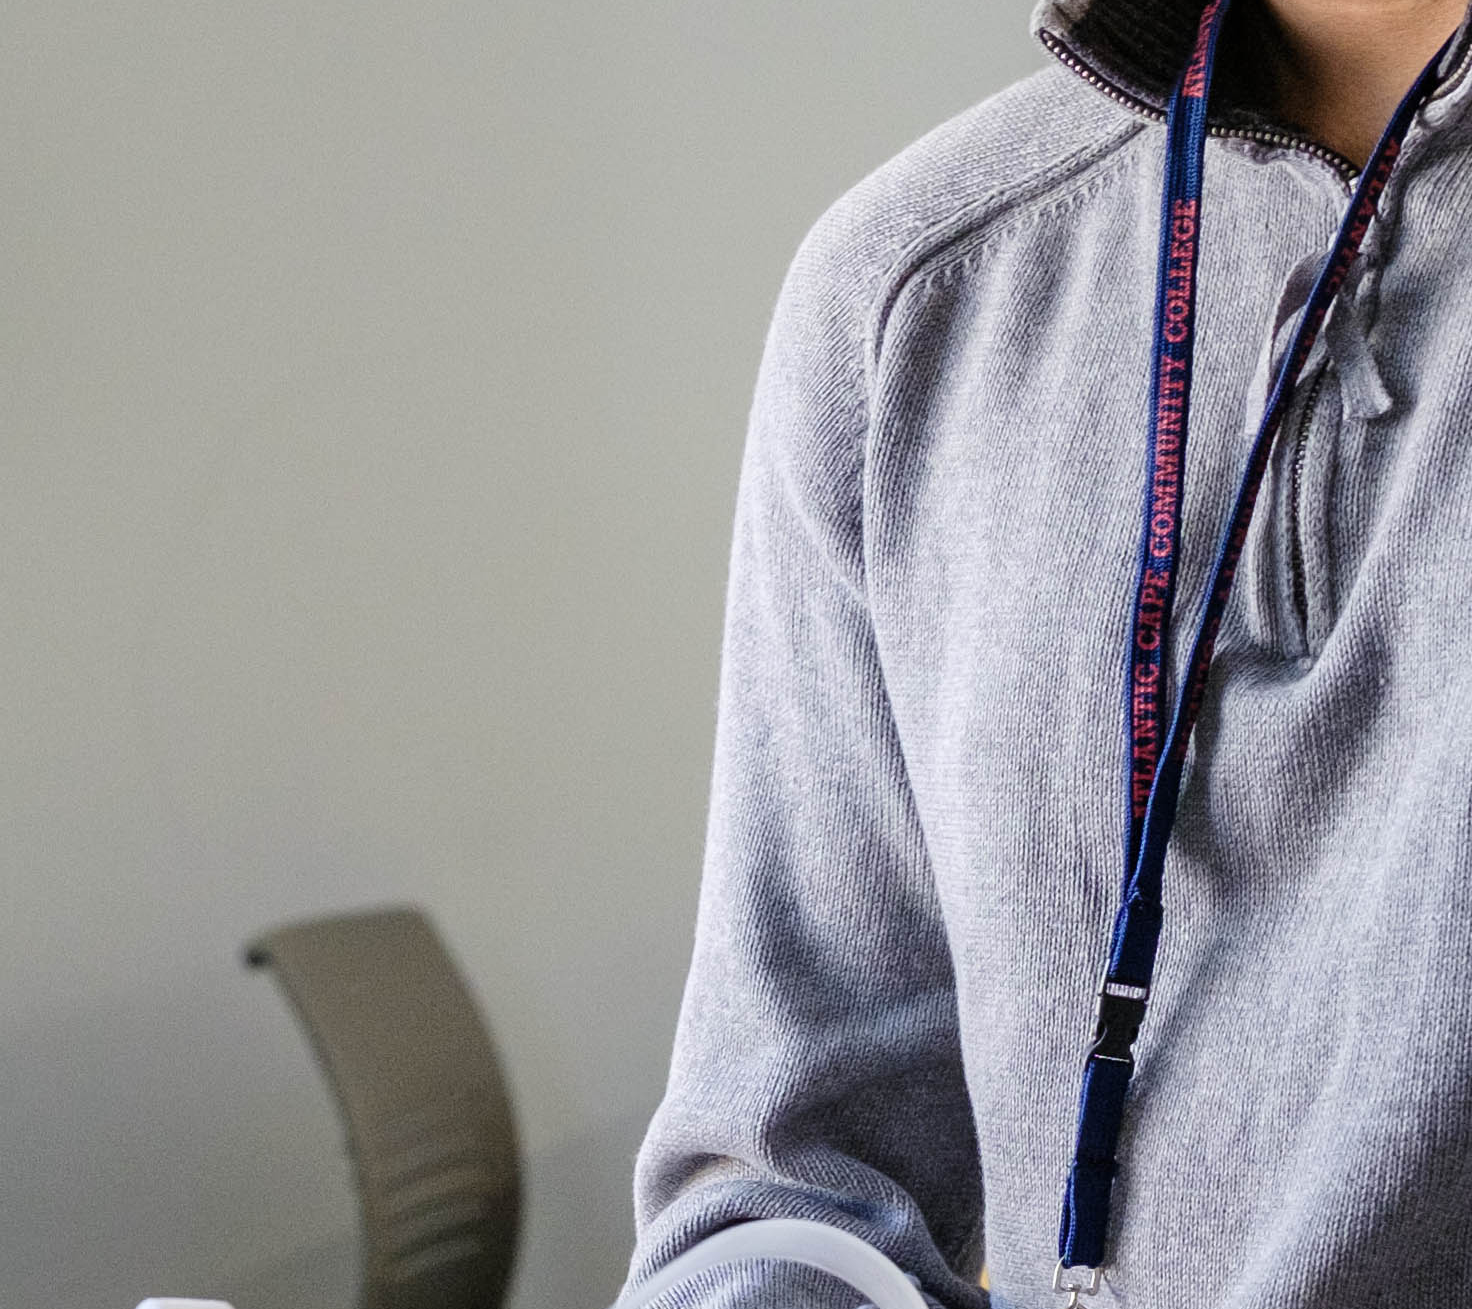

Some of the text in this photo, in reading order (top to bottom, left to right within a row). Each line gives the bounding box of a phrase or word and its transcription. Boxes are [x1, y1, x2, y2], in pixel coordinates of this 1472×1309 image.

[1163, 198, 1197, 344] COLLEGE
[1150, 355, 1187, 558] COMMUNITY
[1137, 568, 1170, 651] CAPE
